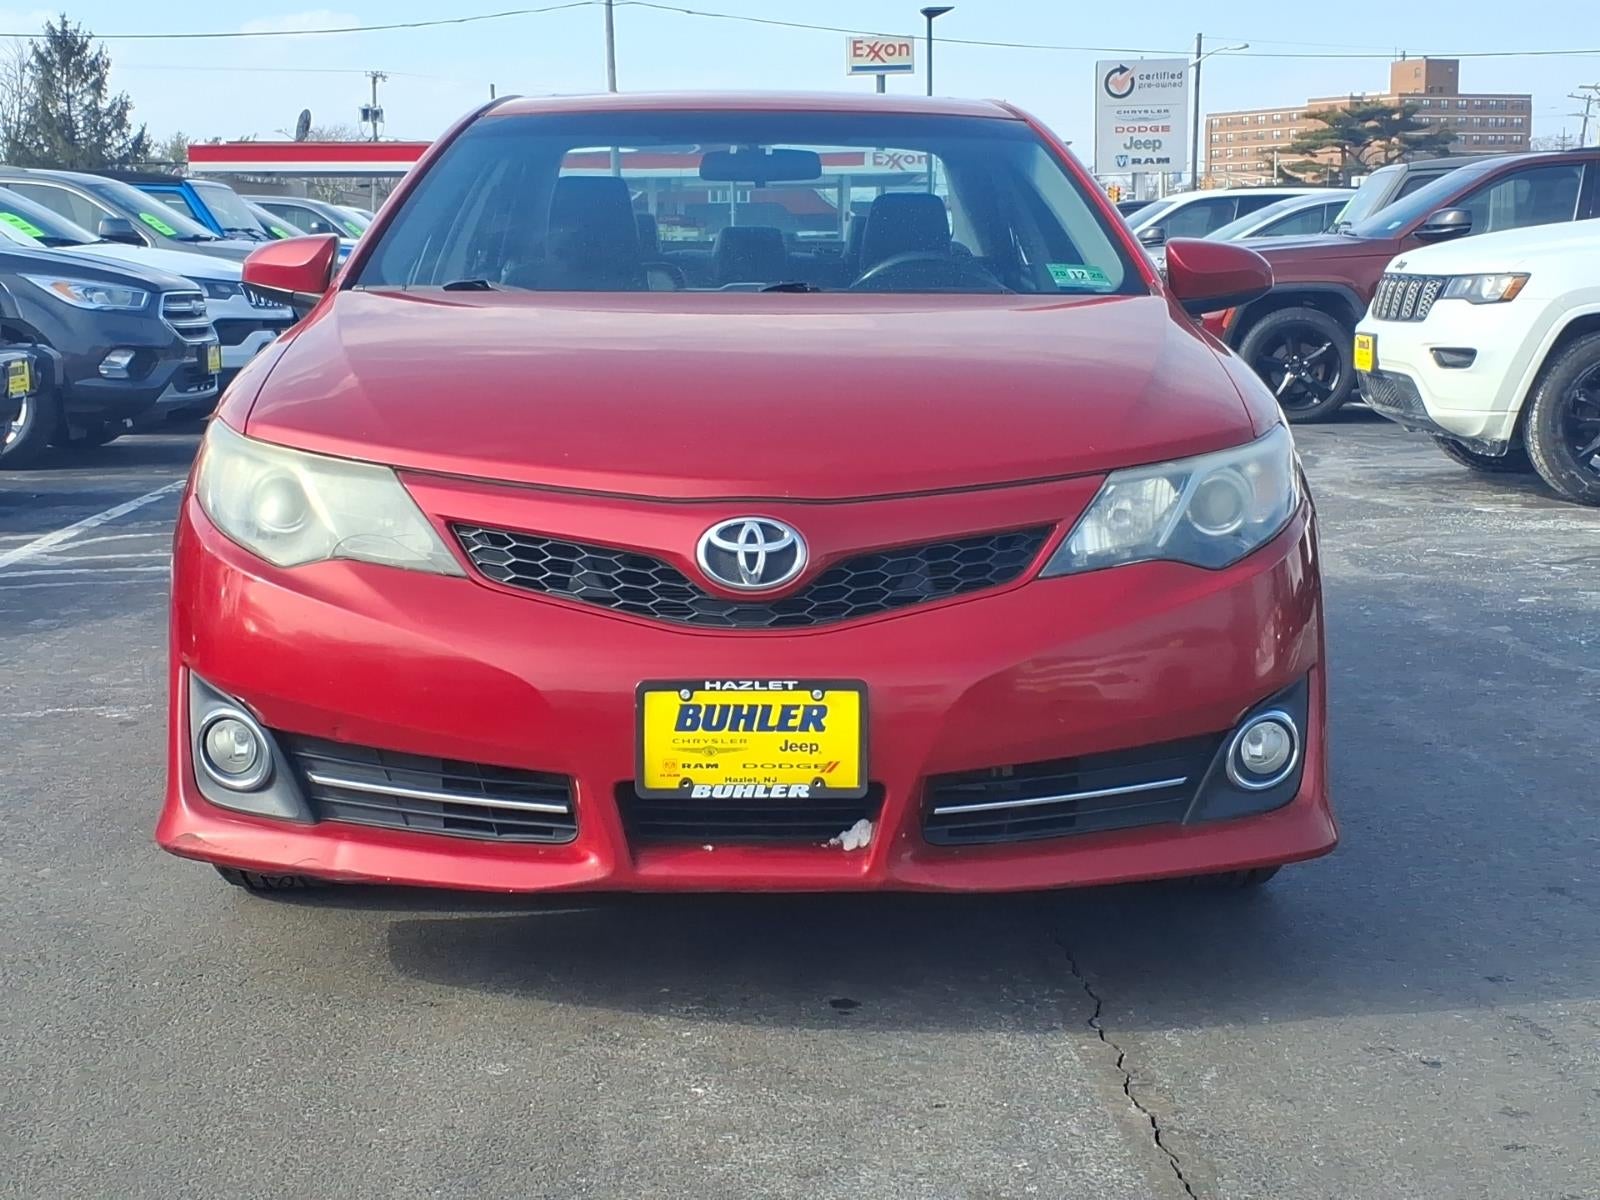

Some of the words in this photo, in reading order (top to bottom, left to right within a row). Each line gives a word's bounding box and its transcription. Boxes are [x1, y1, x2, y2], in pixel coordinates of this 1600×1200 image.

[852, 40, 910, 63] Exxon
[1138, 71, 1183, 80] certified
[1138, 81, 1183, 89] pre-owned
[1115, 125, 1171, 133] DODGE
[1123, 136, 1163, 152] Jeep
[872, 152, 928, 171] Exxon
[1131, 157, 1170, 165] RAM
[1071, 270, 1085, 280] 12
[704, 681, 799, 690] HAZLET
[674, 703, 828, 733] BUHLER
[779, 739, 820, 755] Jeep
[691, 784, 810, 799] BUHLER
